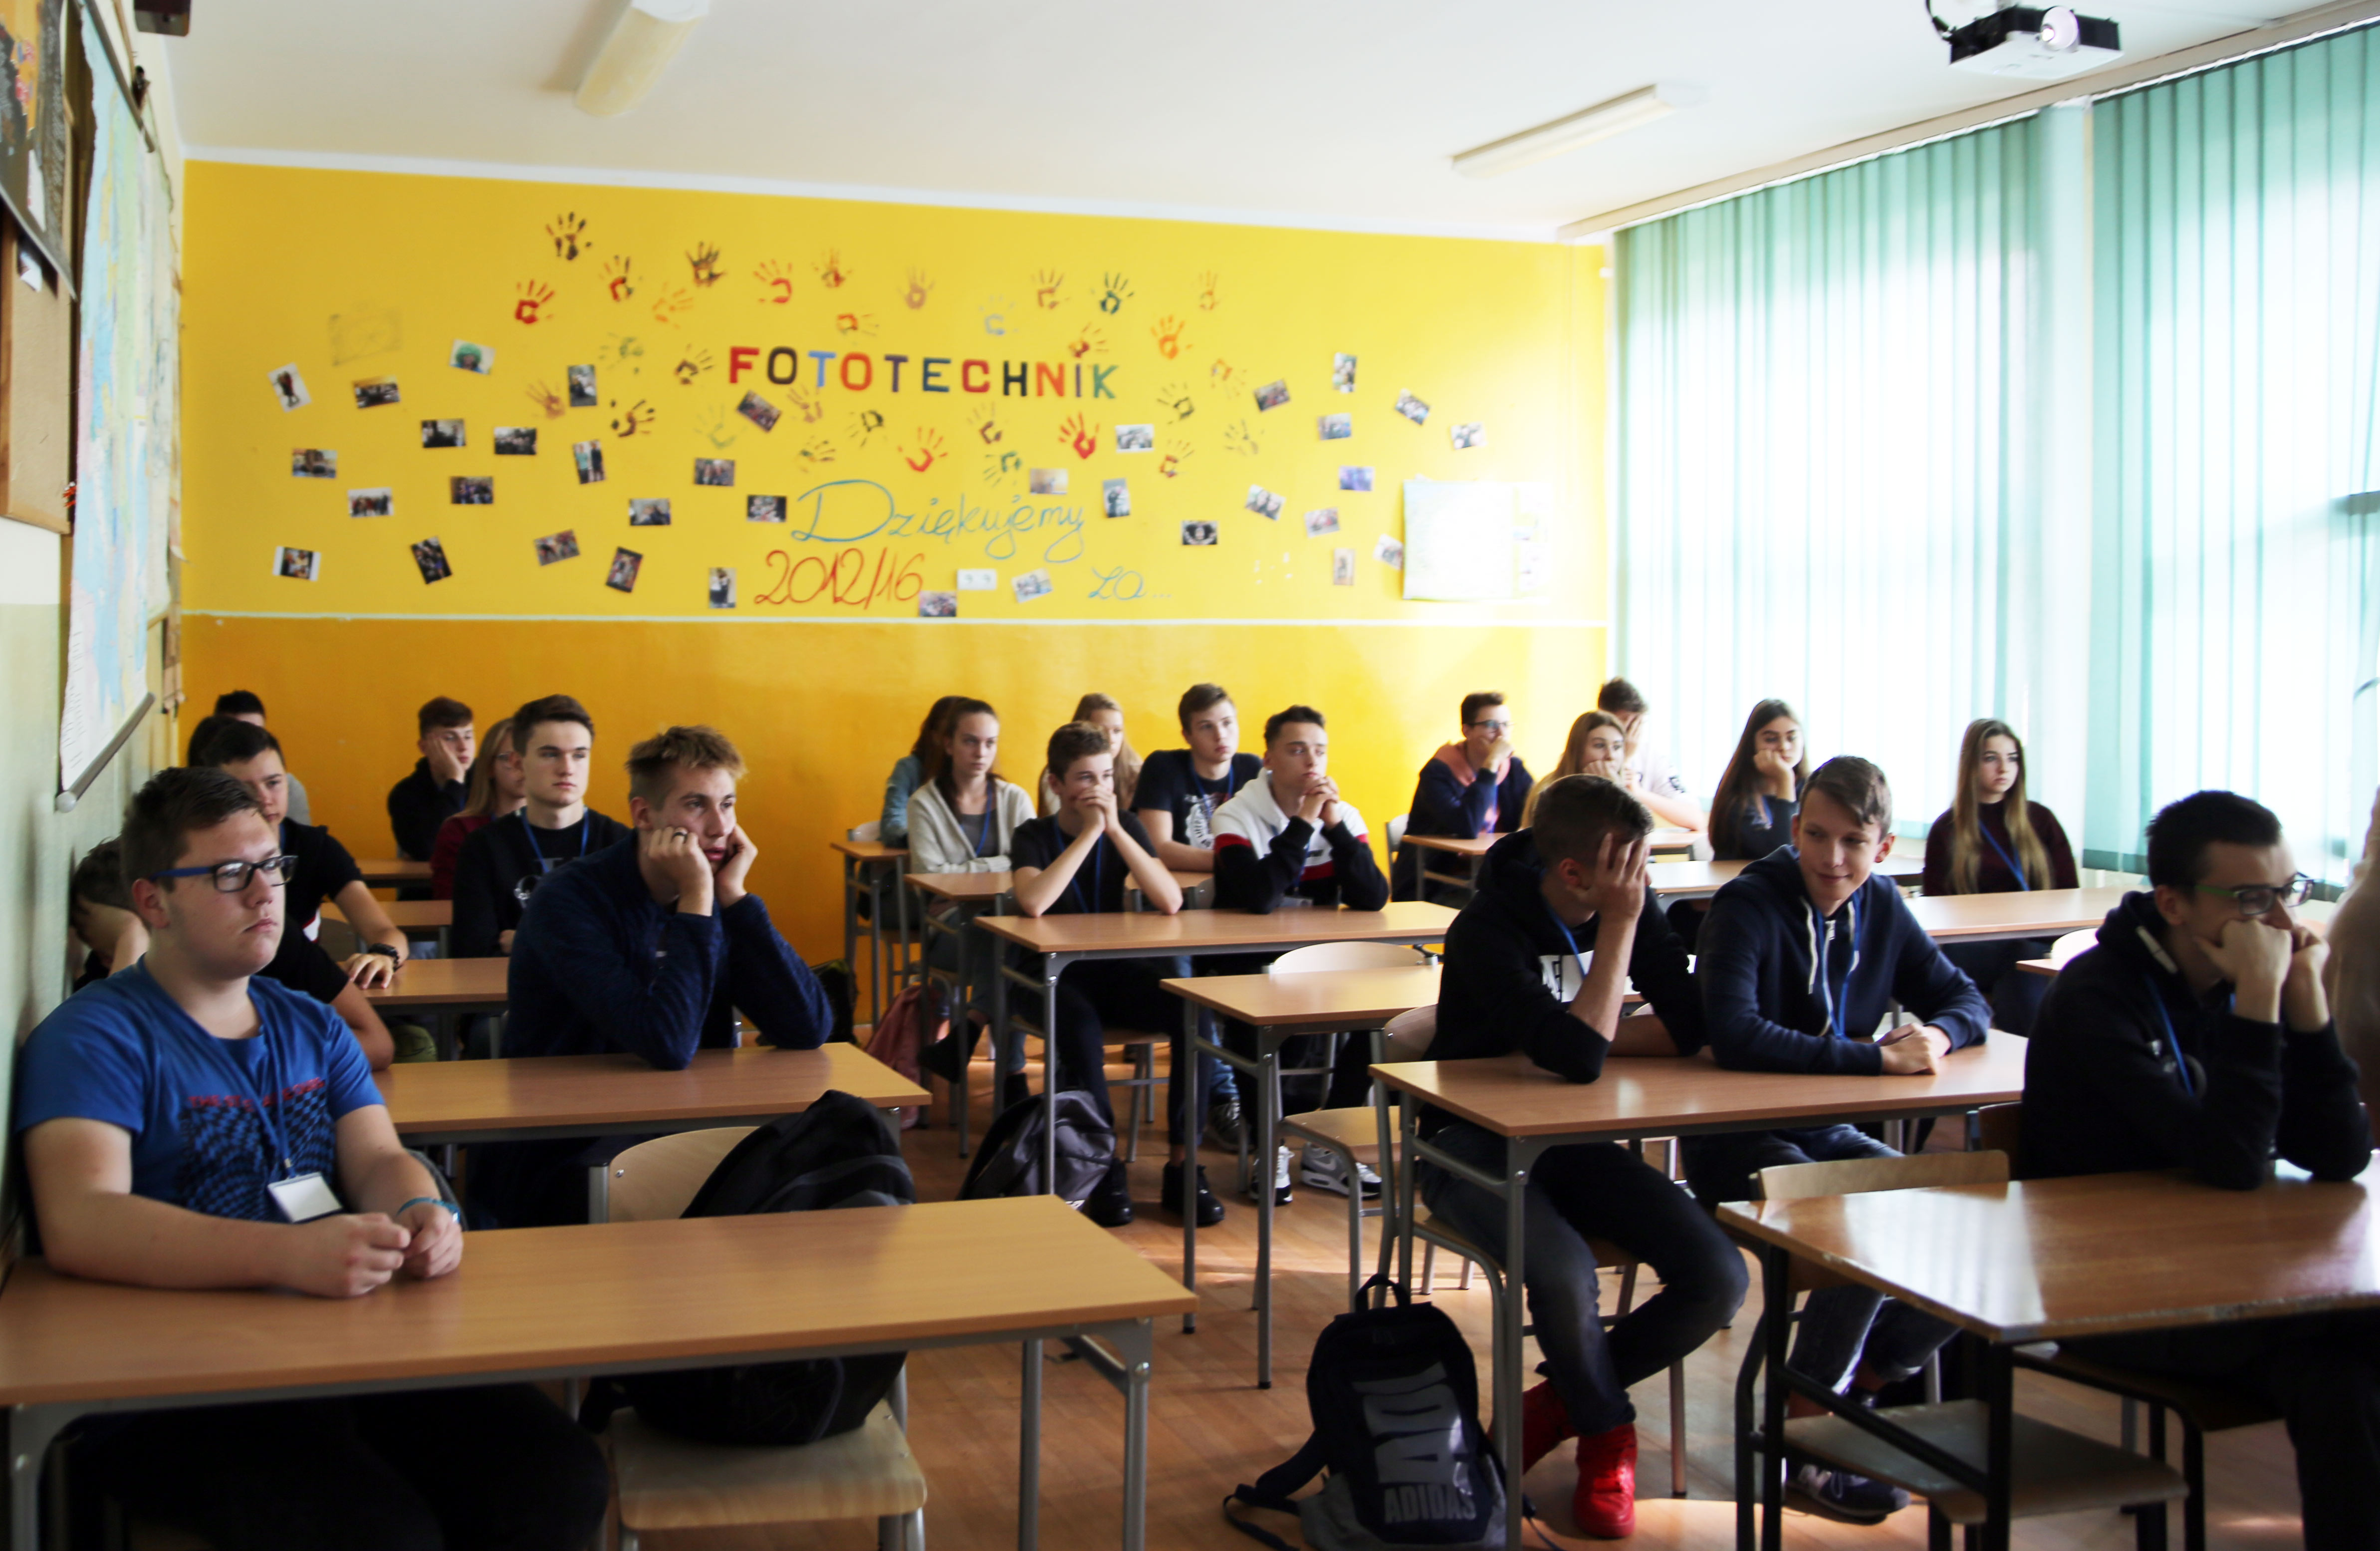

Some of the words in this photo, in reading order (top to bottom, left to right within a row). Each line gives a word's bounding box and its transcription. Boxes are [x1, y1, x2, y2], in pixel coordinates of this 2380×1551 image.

[728, 346, 1119, 399] FOTOTECHNIK
[790, 479, 1085, 563] Dziękujemy
[754, 547, 926, 610] 2012/16
[1384, 1484, 1477, 1525] ADIDAS
